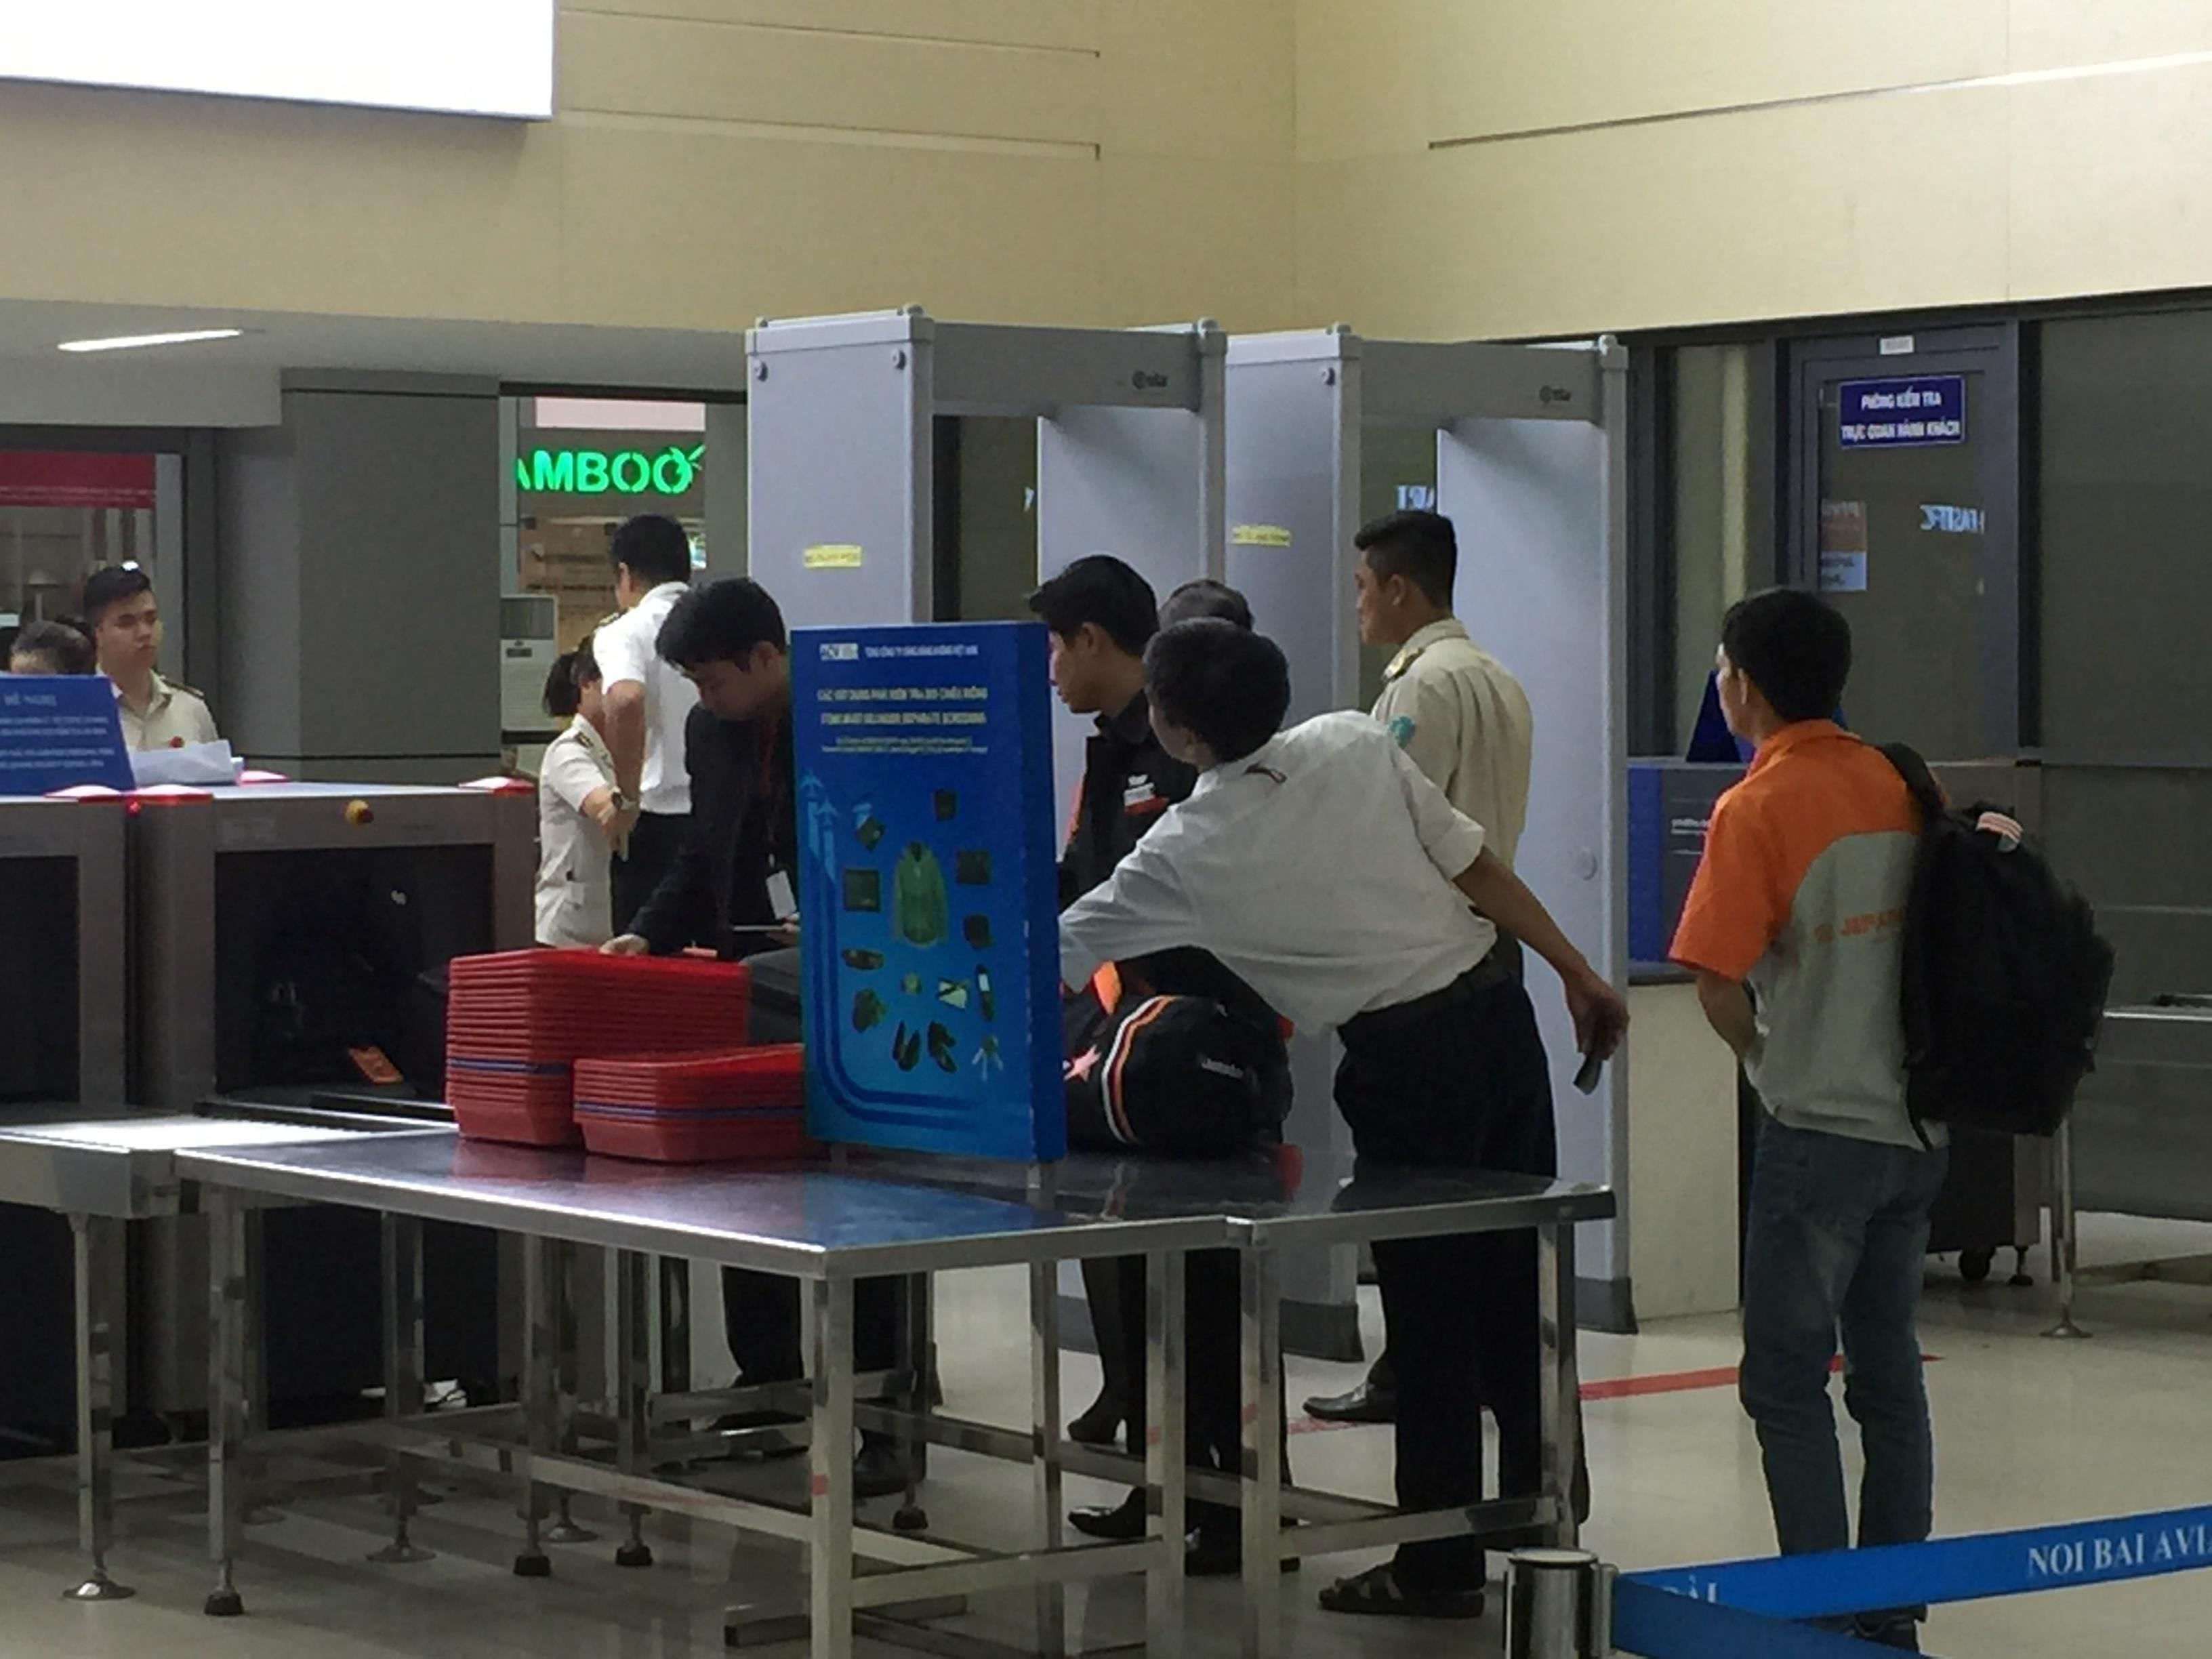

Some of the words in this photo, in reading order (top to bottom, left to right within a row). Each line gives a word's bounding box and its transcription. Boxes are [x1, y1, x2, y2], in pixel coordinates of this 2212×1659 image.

[2028, 1542, 2085, 1576] NOI
[2094, 1534, 2145, 1570] BAI
[2155, 1525, 2212, 1560] AVI
